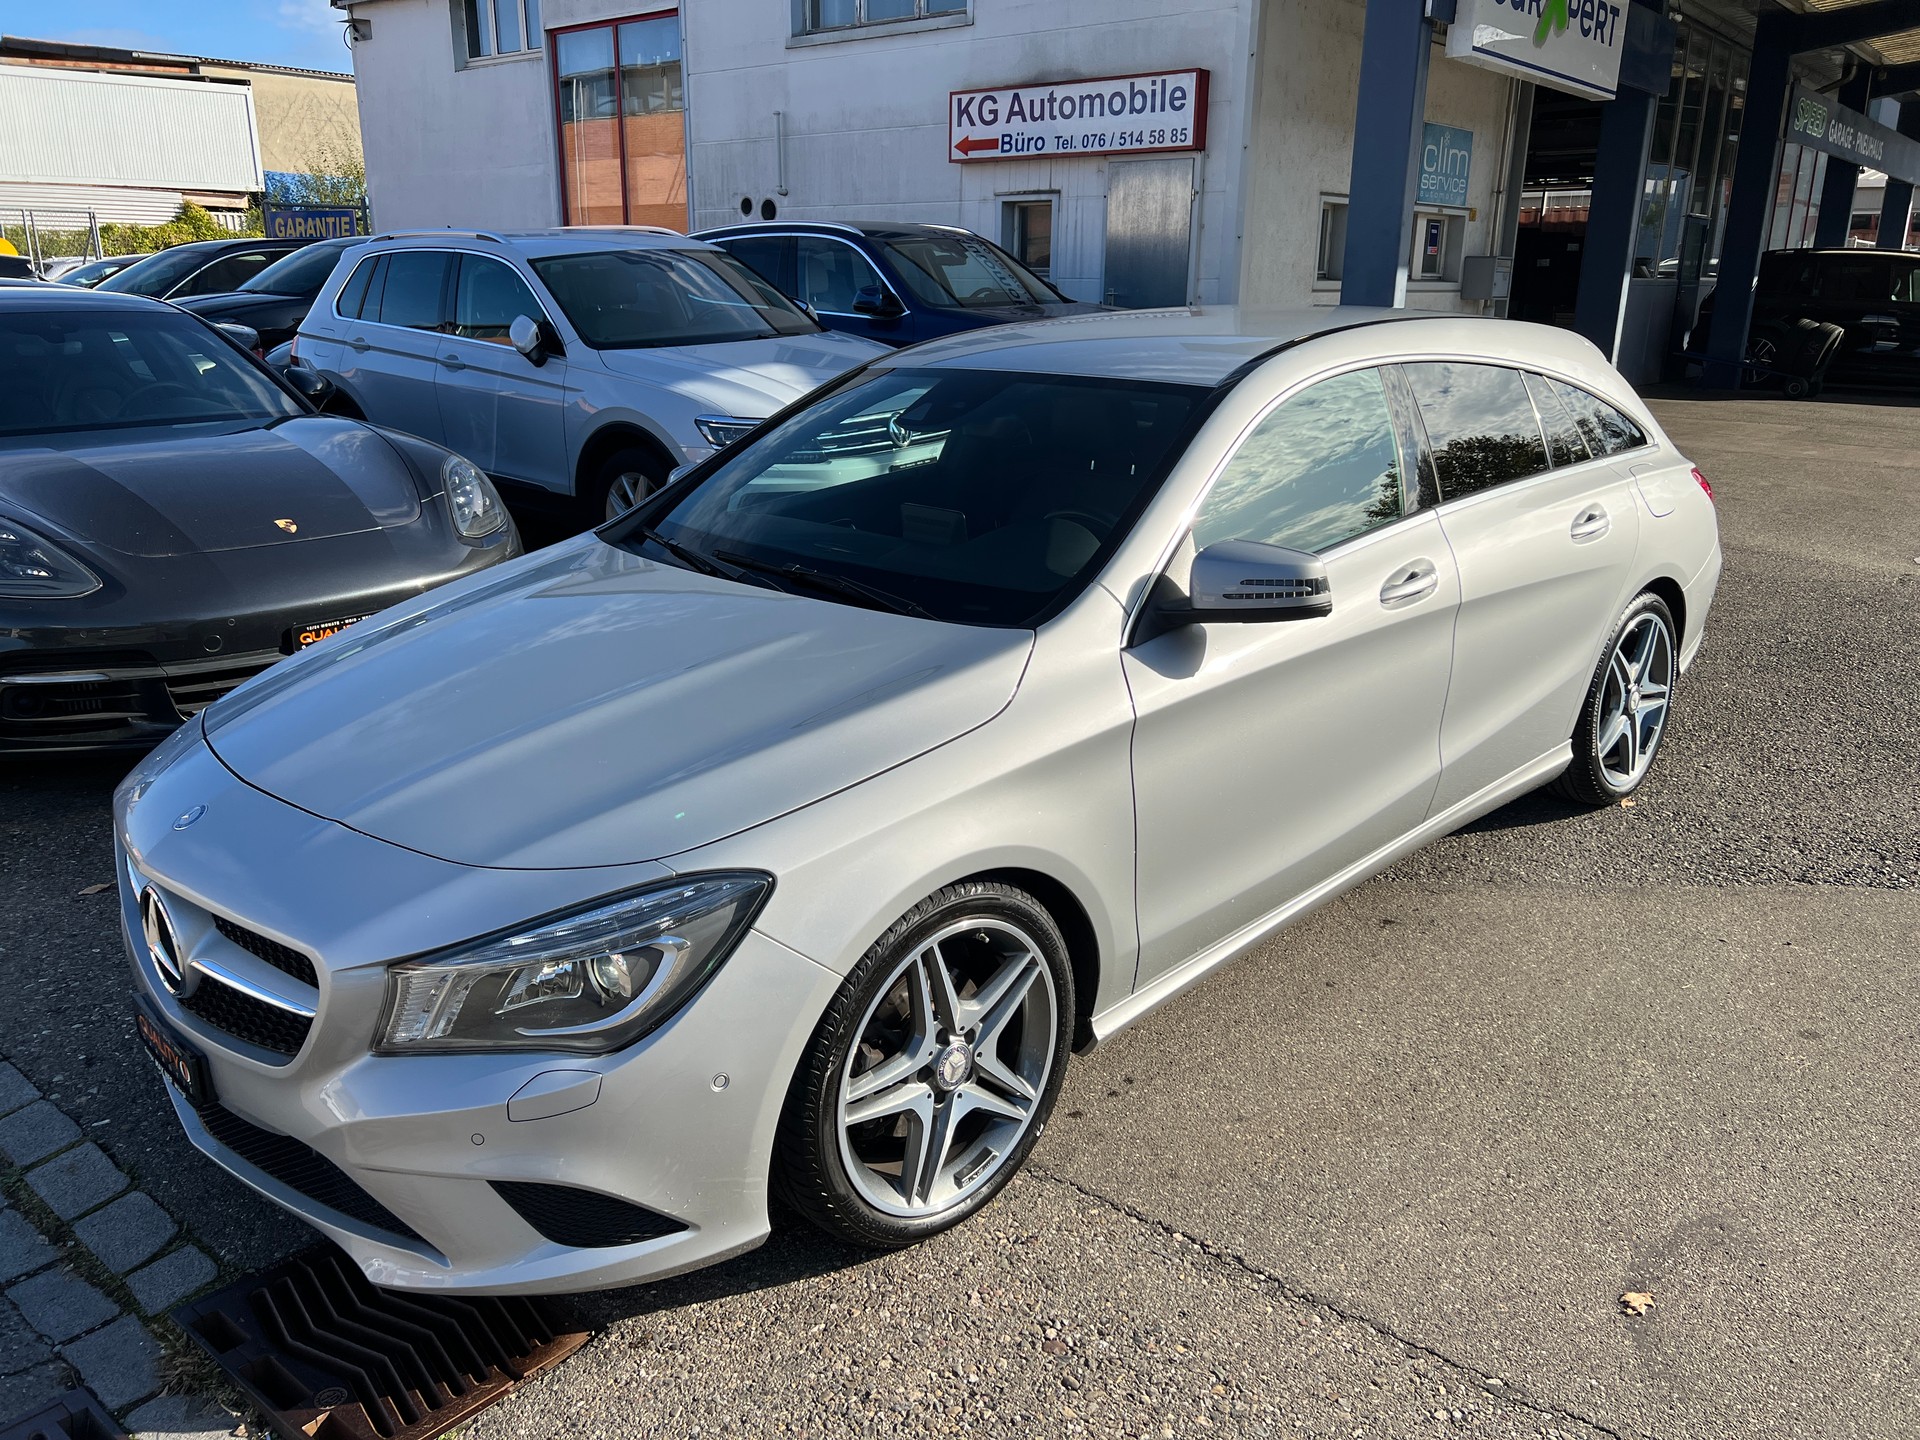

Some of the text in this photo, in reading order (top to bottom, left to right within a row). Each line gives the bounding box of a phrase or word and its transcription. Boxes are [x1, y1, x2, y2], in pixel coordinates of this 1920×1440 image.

[956, 79, 1187, 127] KG Automobile
[1794, 97, 1828, 138] SPEED
[1828, 119, 1854, 149] GARAGE
[1000, 132, 1046, 153] Büro
[1054, 135, 1077, 150] Tel.
[1081, 133, 1106, 149] 076
[1118, 130, 1144, 146] 514
[1148, 128, 1166, 145] 58
[1170, 127, 1188, 143] 85
[1423, 136, 1469, 177] clim
[1421, 173, 1466, 193] service
[274, 216, 351, 239] GARANTIE
[299, 625, 352, 645] QUAL
